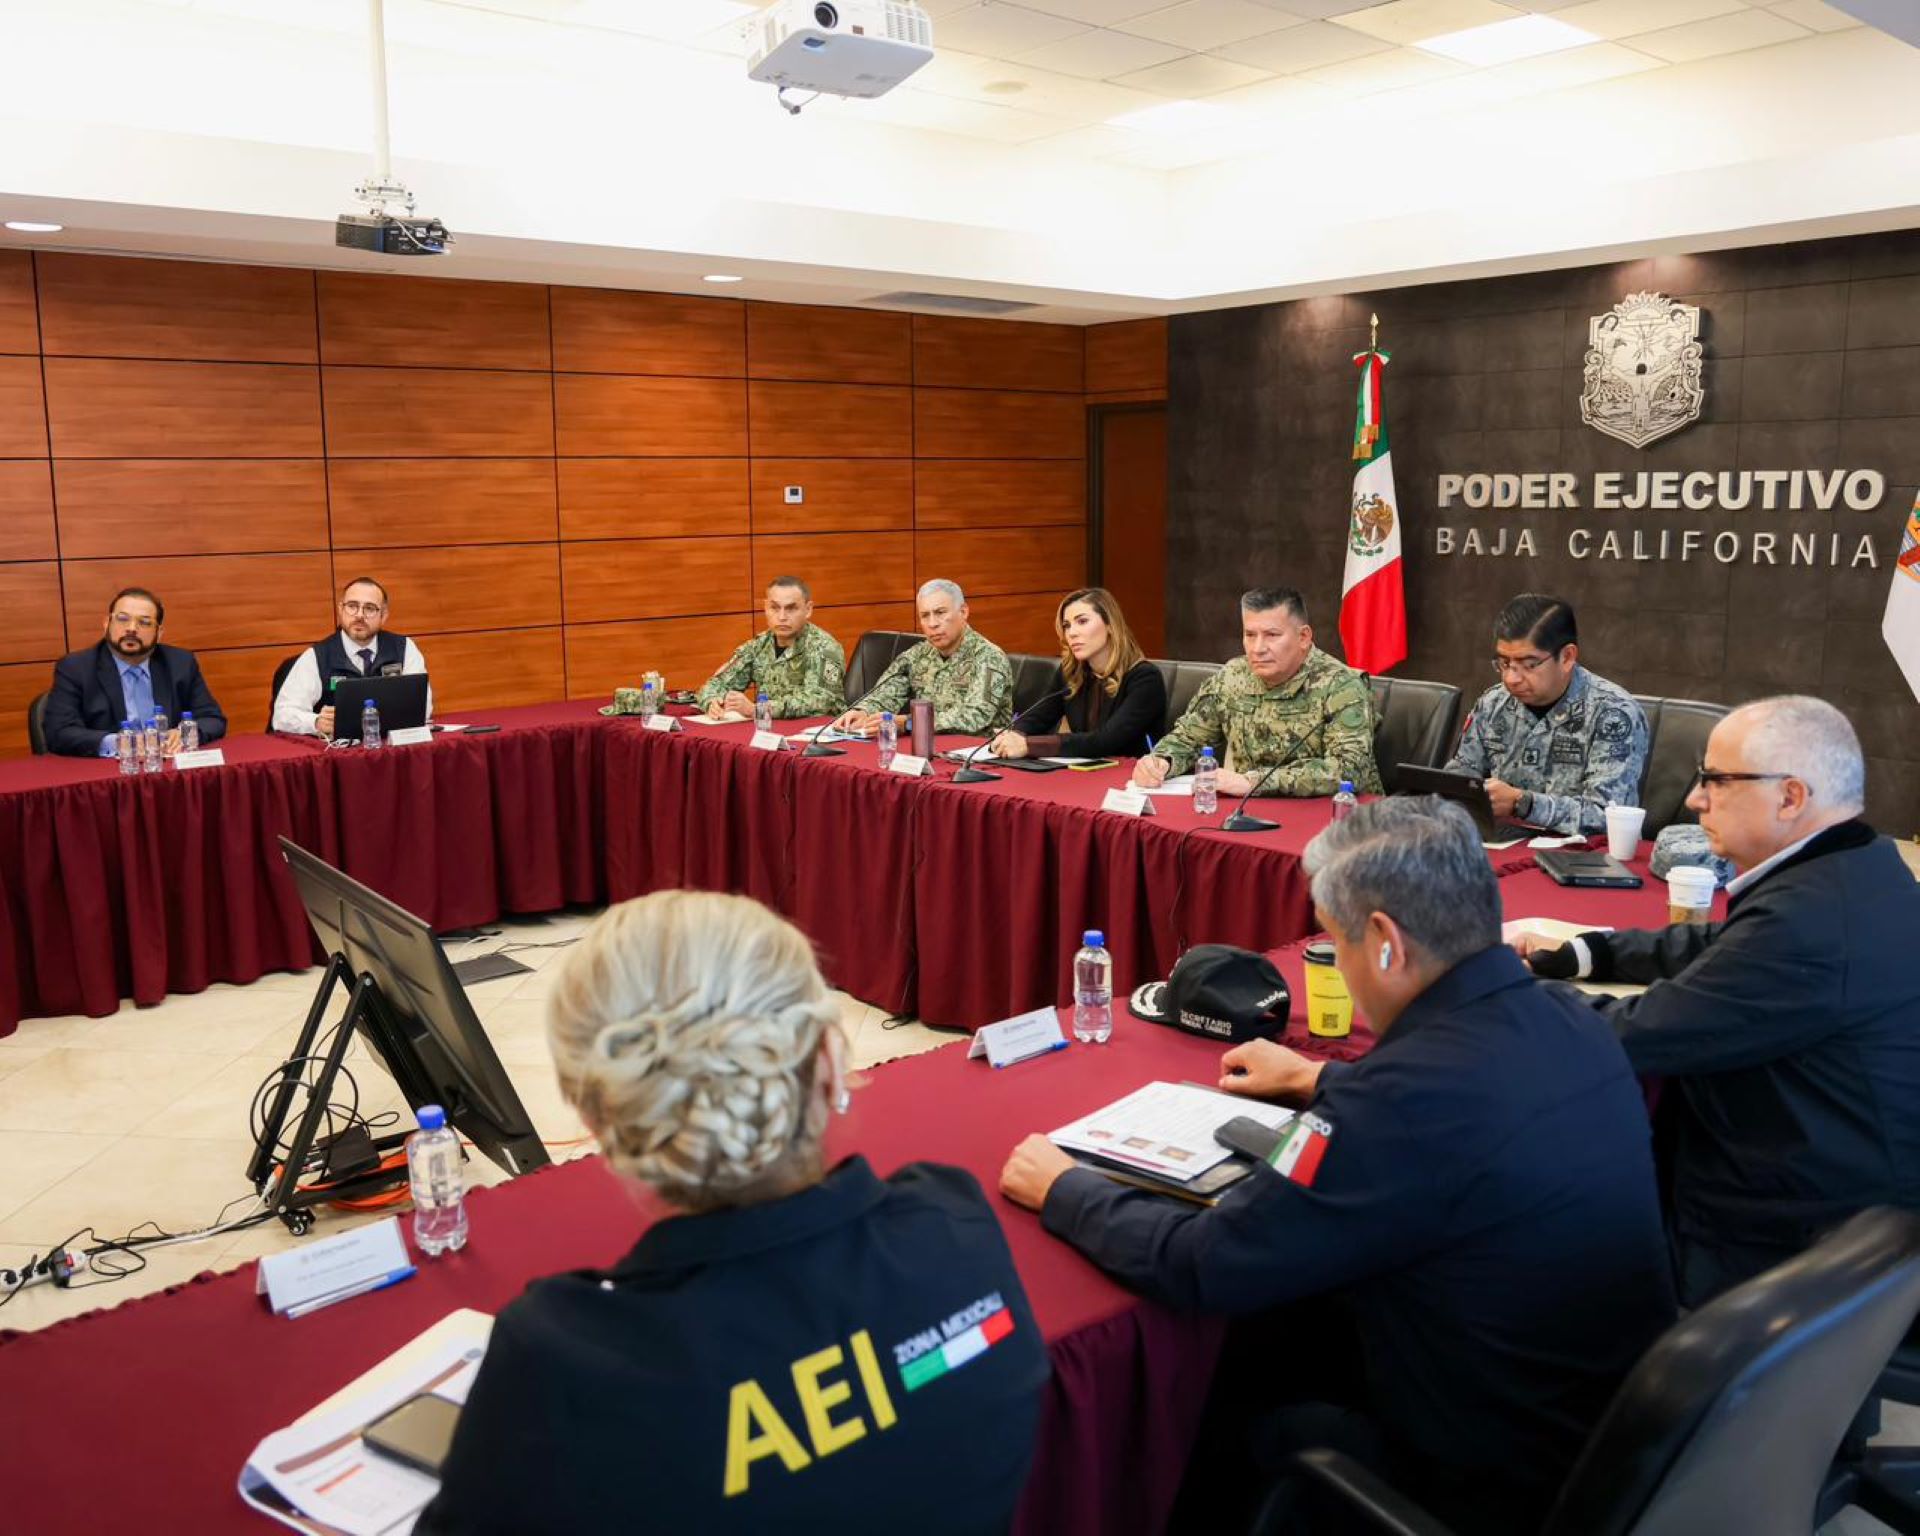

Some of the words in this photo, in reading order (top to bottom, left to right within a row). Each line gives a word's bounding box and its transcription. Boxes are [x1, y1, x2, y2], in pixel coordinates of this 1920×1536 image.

[1438, 473, 1579, 508] PODER
[1593, 469, 1884, 511] EJECUTIVO
[1435, 527, 1538, 557] BAJA
[1568, 529, 1879, 568] CALIFORNIA
[893, 1326, 944, 1365] ZONA
[724, 1329, 897, 1497] AEI
